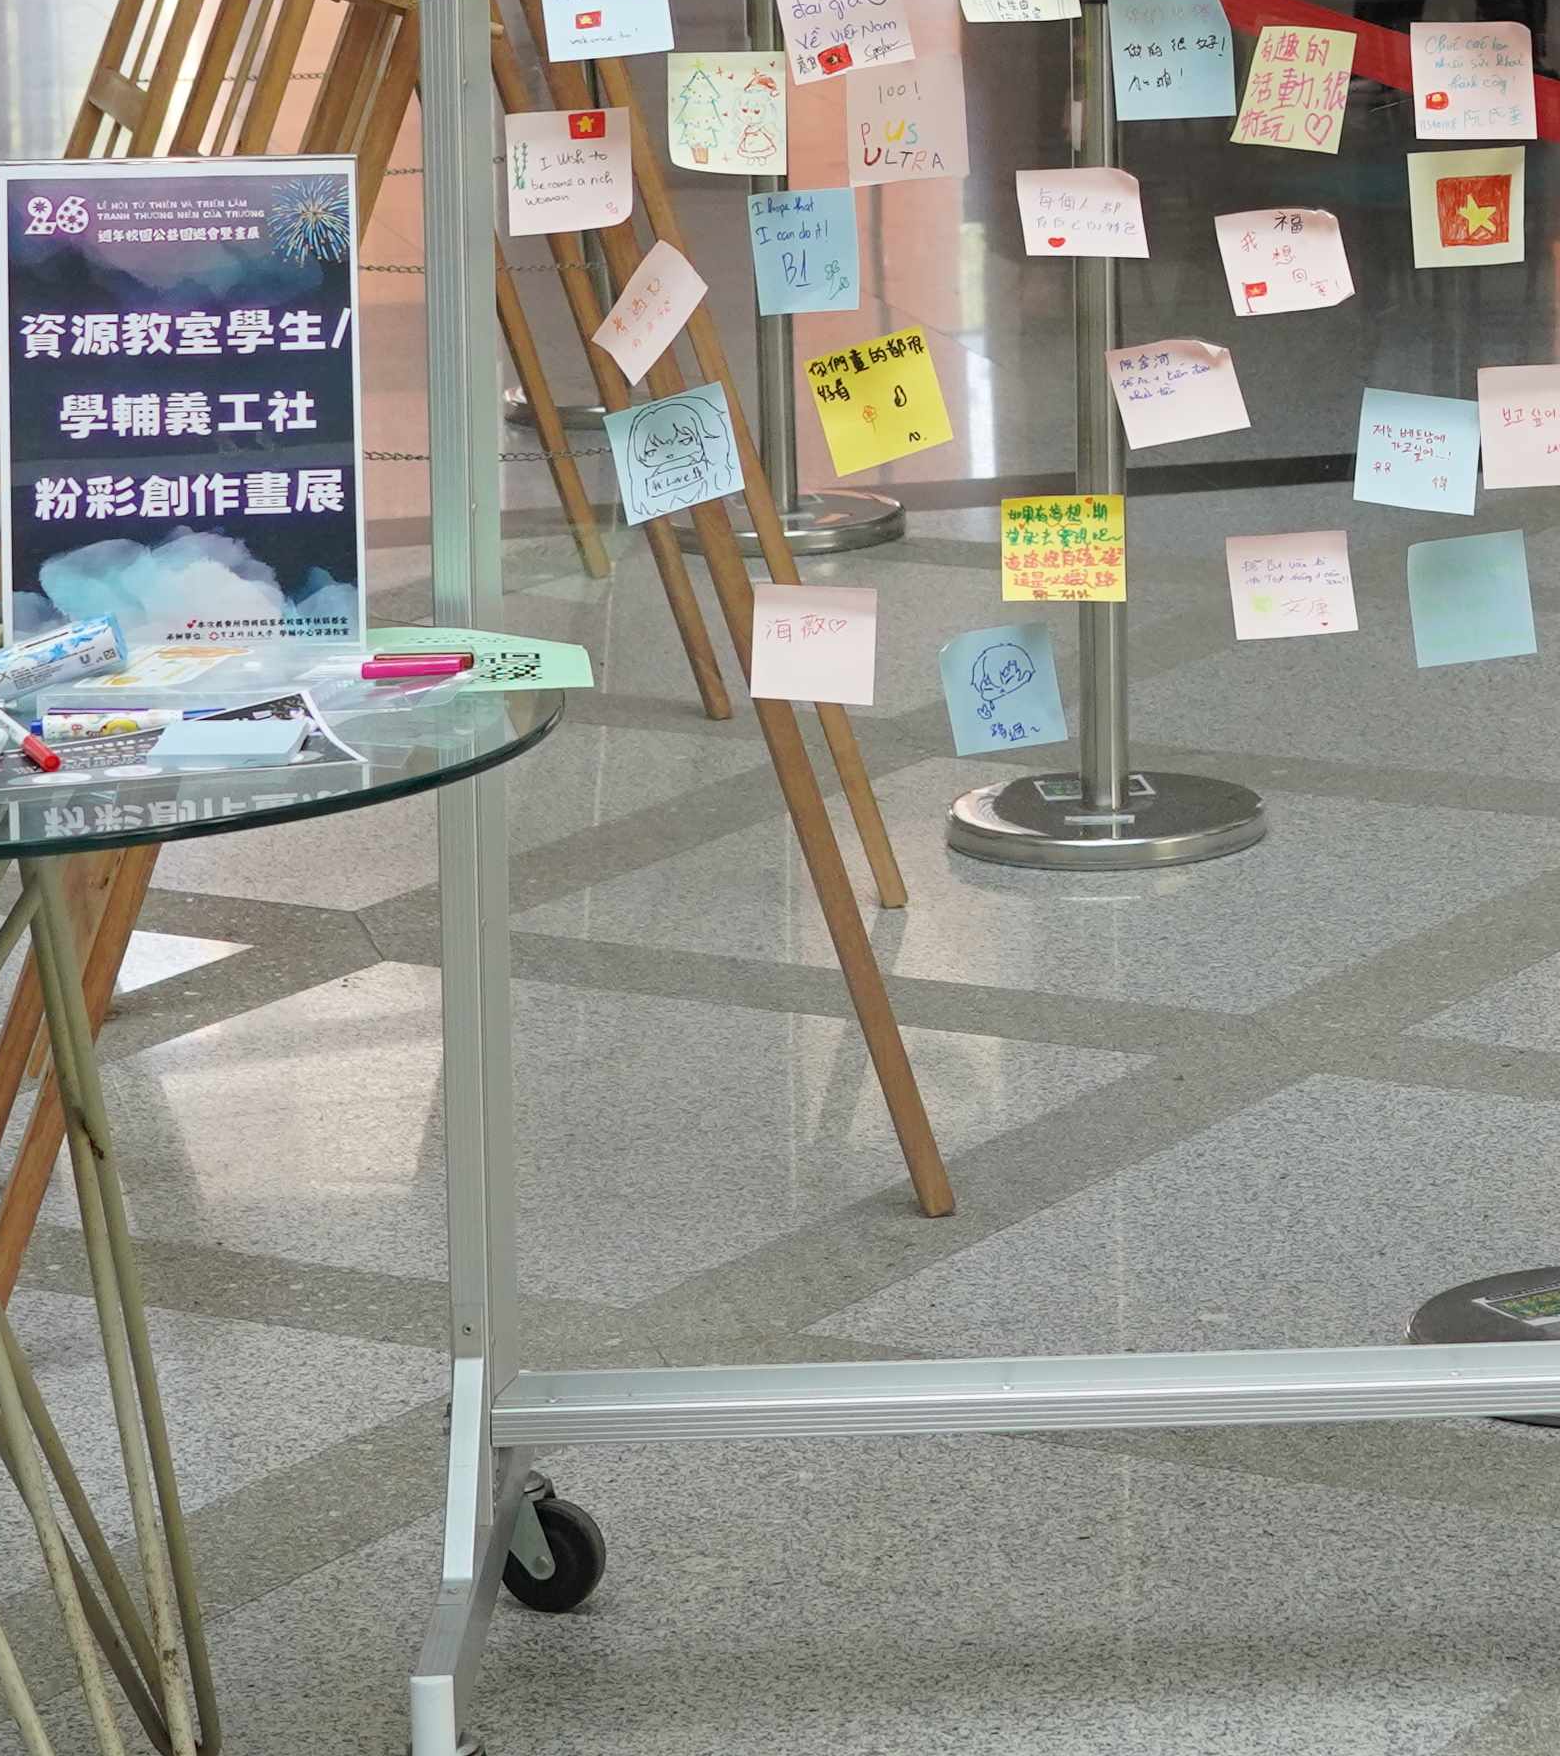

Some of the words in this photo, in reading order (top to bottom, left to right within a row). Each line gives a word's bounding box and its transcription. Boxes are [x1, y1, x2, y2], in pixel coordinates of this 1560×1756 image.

[1259, 32, 1331, 67] 有趣的
[862, 146, 945, 171] ULTRA
[751, 199, 764, 216] I
[755, 228, 770, 246] I
[776, 227, 795, 240] can
[18, 307, 352, 360] 資源教室學生/
[58, 390, 318, 440] 學輔義工社
[34, 468, 345, 521] 粉彩創作畫展
